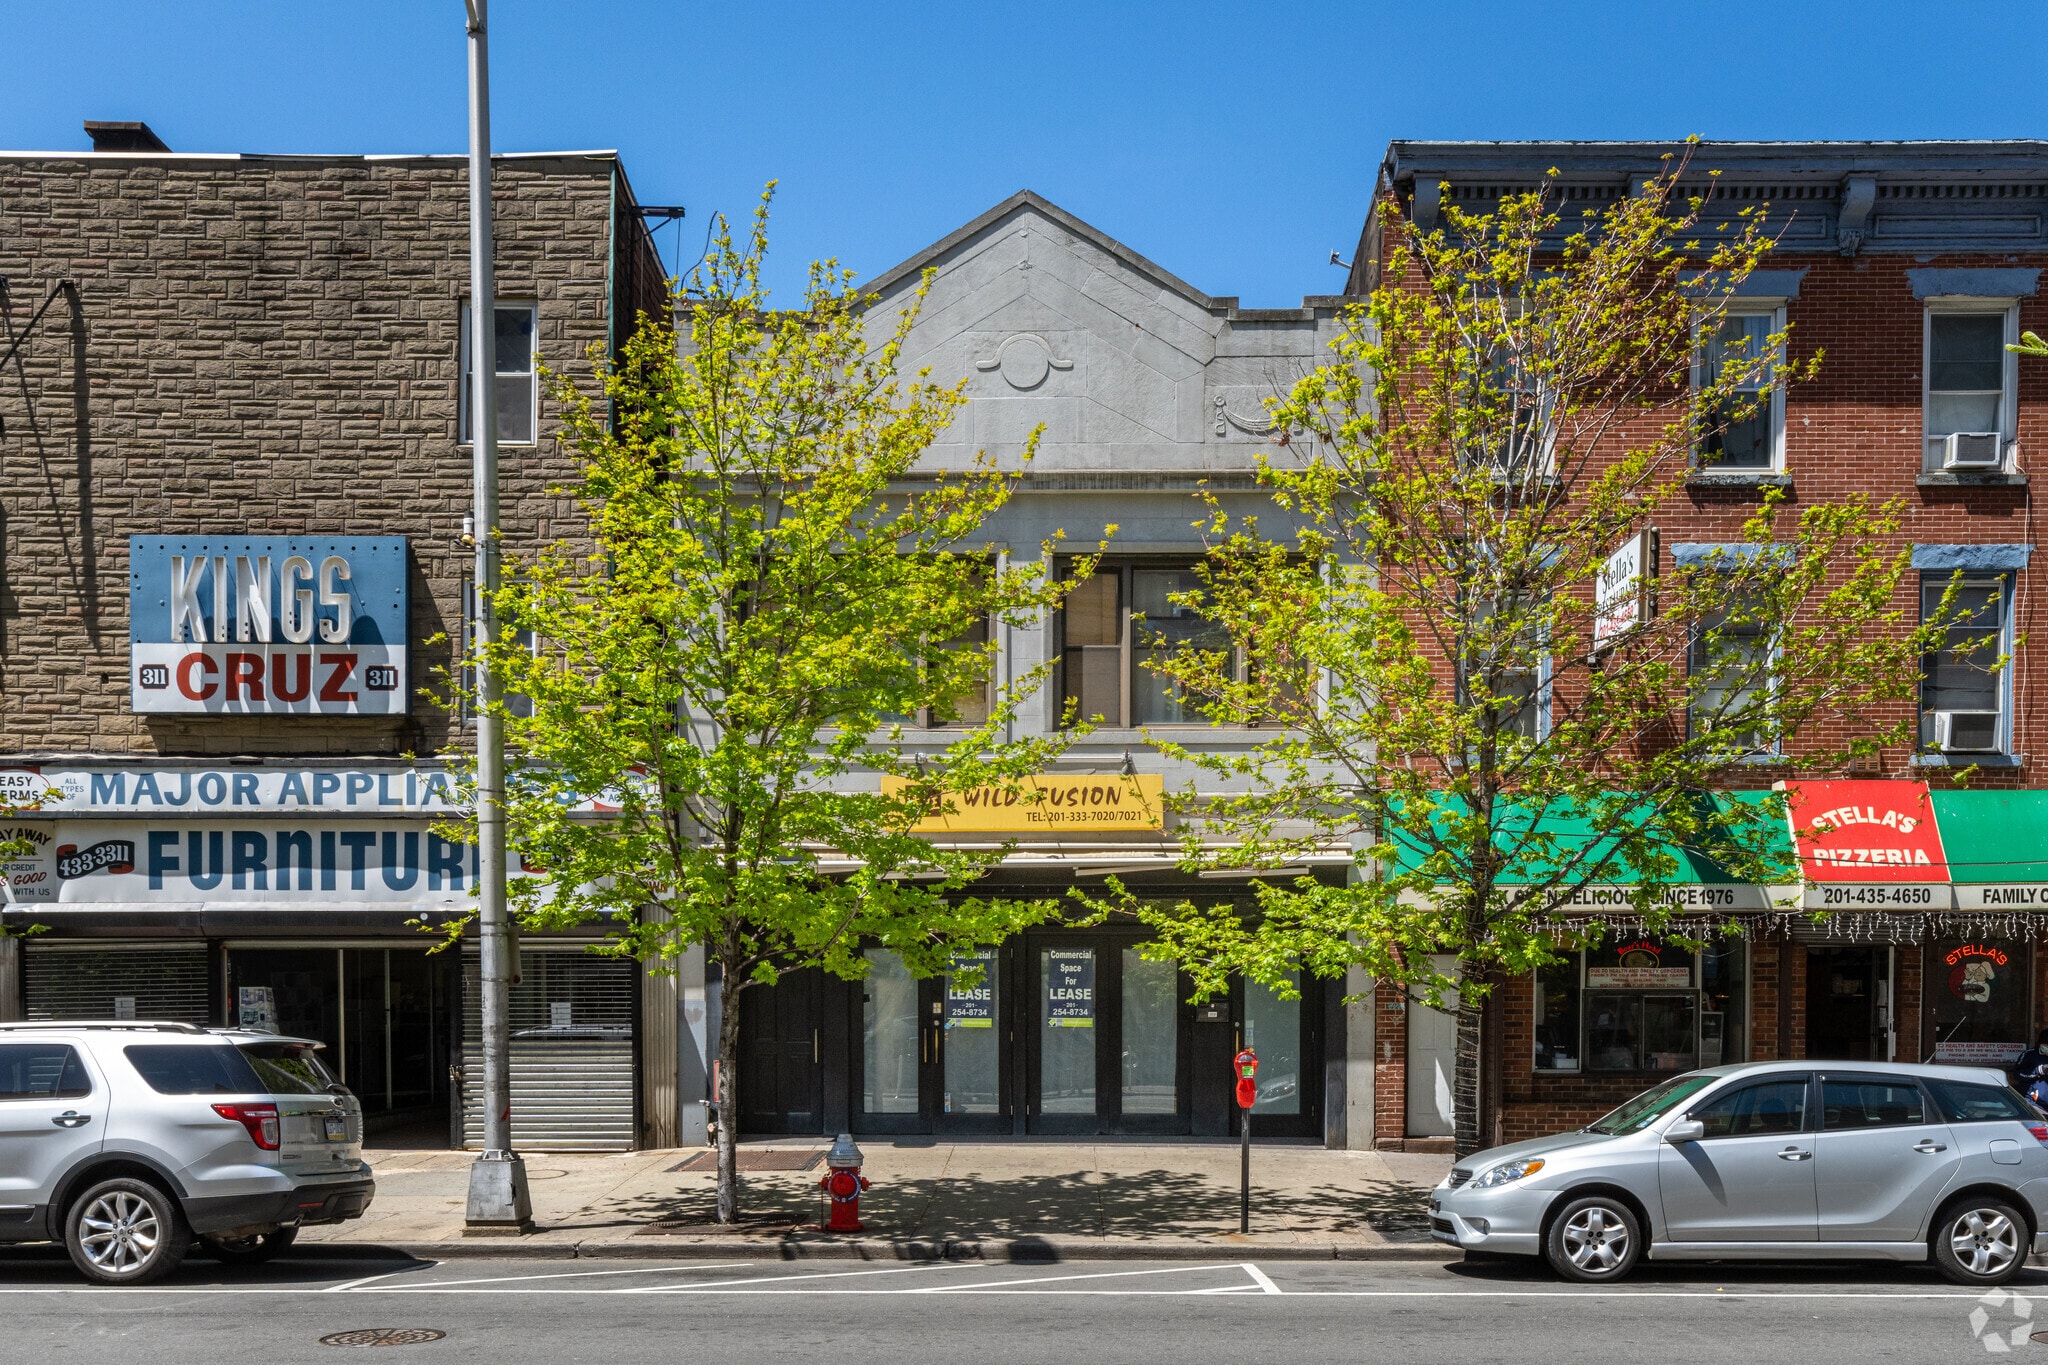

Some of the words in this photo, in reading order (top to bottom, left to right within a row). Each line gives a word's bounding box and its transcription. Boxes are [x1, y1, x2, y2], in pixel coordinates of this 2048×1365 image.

[1602, 551, 1634, 594] Stella's
[170, 555, 352, 643] KINGS
[142, 669, 166, 685] 311
[176, 652, 358, 702] CRUZ
[368, 670, 394, 686] 311
[90, 772, 261, 806] MAJOR
[963, 788, 1020, 808] WILD
[1034, 786, 1122, 808] FUSION
[1026, 812, 1047, 822] TEL:
[1048, 811, 1142, 822] 201-333-7020/7021
[1811, 806, 1917, 833] STELLA'S
[15, 827, 52, 846] AWAY
[1812, 848, 1931, 868] PIZZERIA
[10, 863, 36, 872] CREDIT
[13, 871, 47, 886] GOOD
[13, 887, 35, 896] WITH
[38, 888, 51, 896] US
[1699, 889, 1734, 905] 1976
[1824, 887, 1931, 904] 201-435-4650
[1983, 888, 2038, 904] FAMILY
[1050, 950, 1092, 960] Commercial
[1945, 944, 2008, 966] STELLA'S
[1060, 963, 1082, 973] Space
[1065, 977, 1077, 986] For
[949, 988, 991, 1000] LEASE
[1050, 988, 1092, 1000] LEASE
[952, 1008, 988, 1016] 254-8734
[1052, 1008, 1089, 1016] 254-8734
